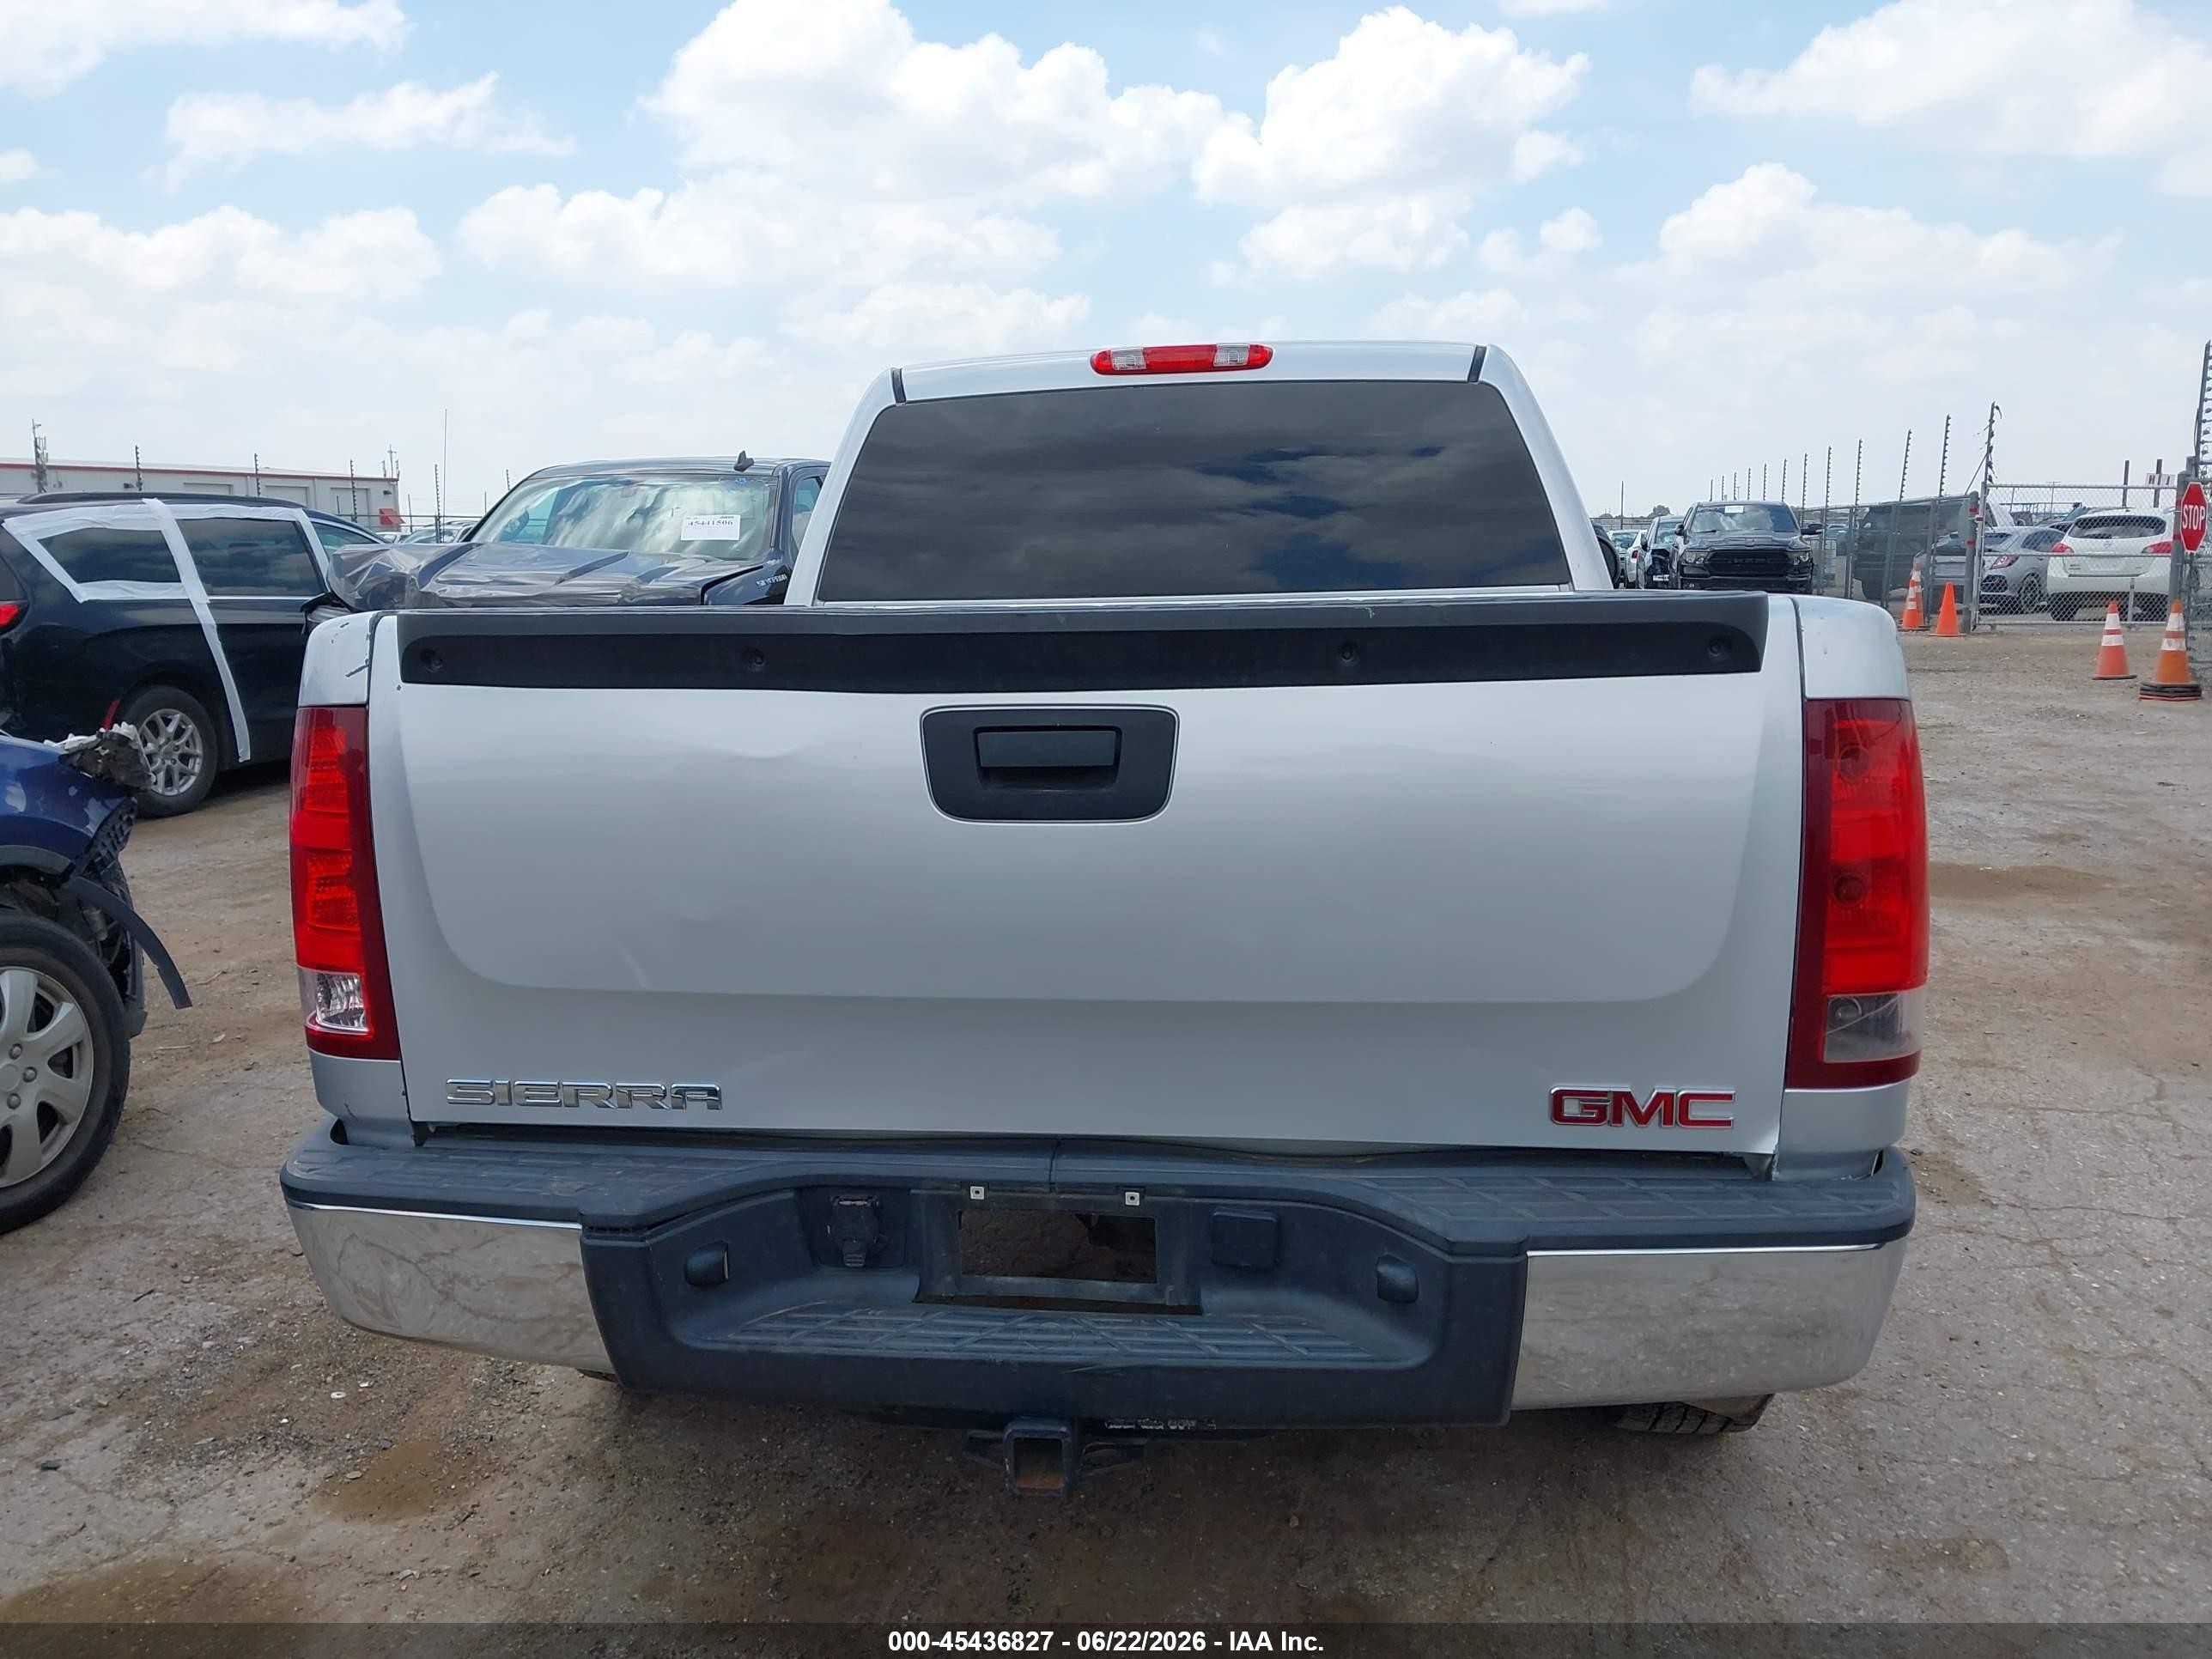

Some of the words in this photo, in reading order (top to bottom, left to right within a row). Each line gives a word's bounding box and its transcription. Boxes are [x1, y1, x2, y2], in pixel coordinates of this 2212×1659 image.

[2182, 504, 2206, 531] STOP
[446, 1079, 723, 1110] SIERRA
[1549, 1085, 1735, 1128] GMC
